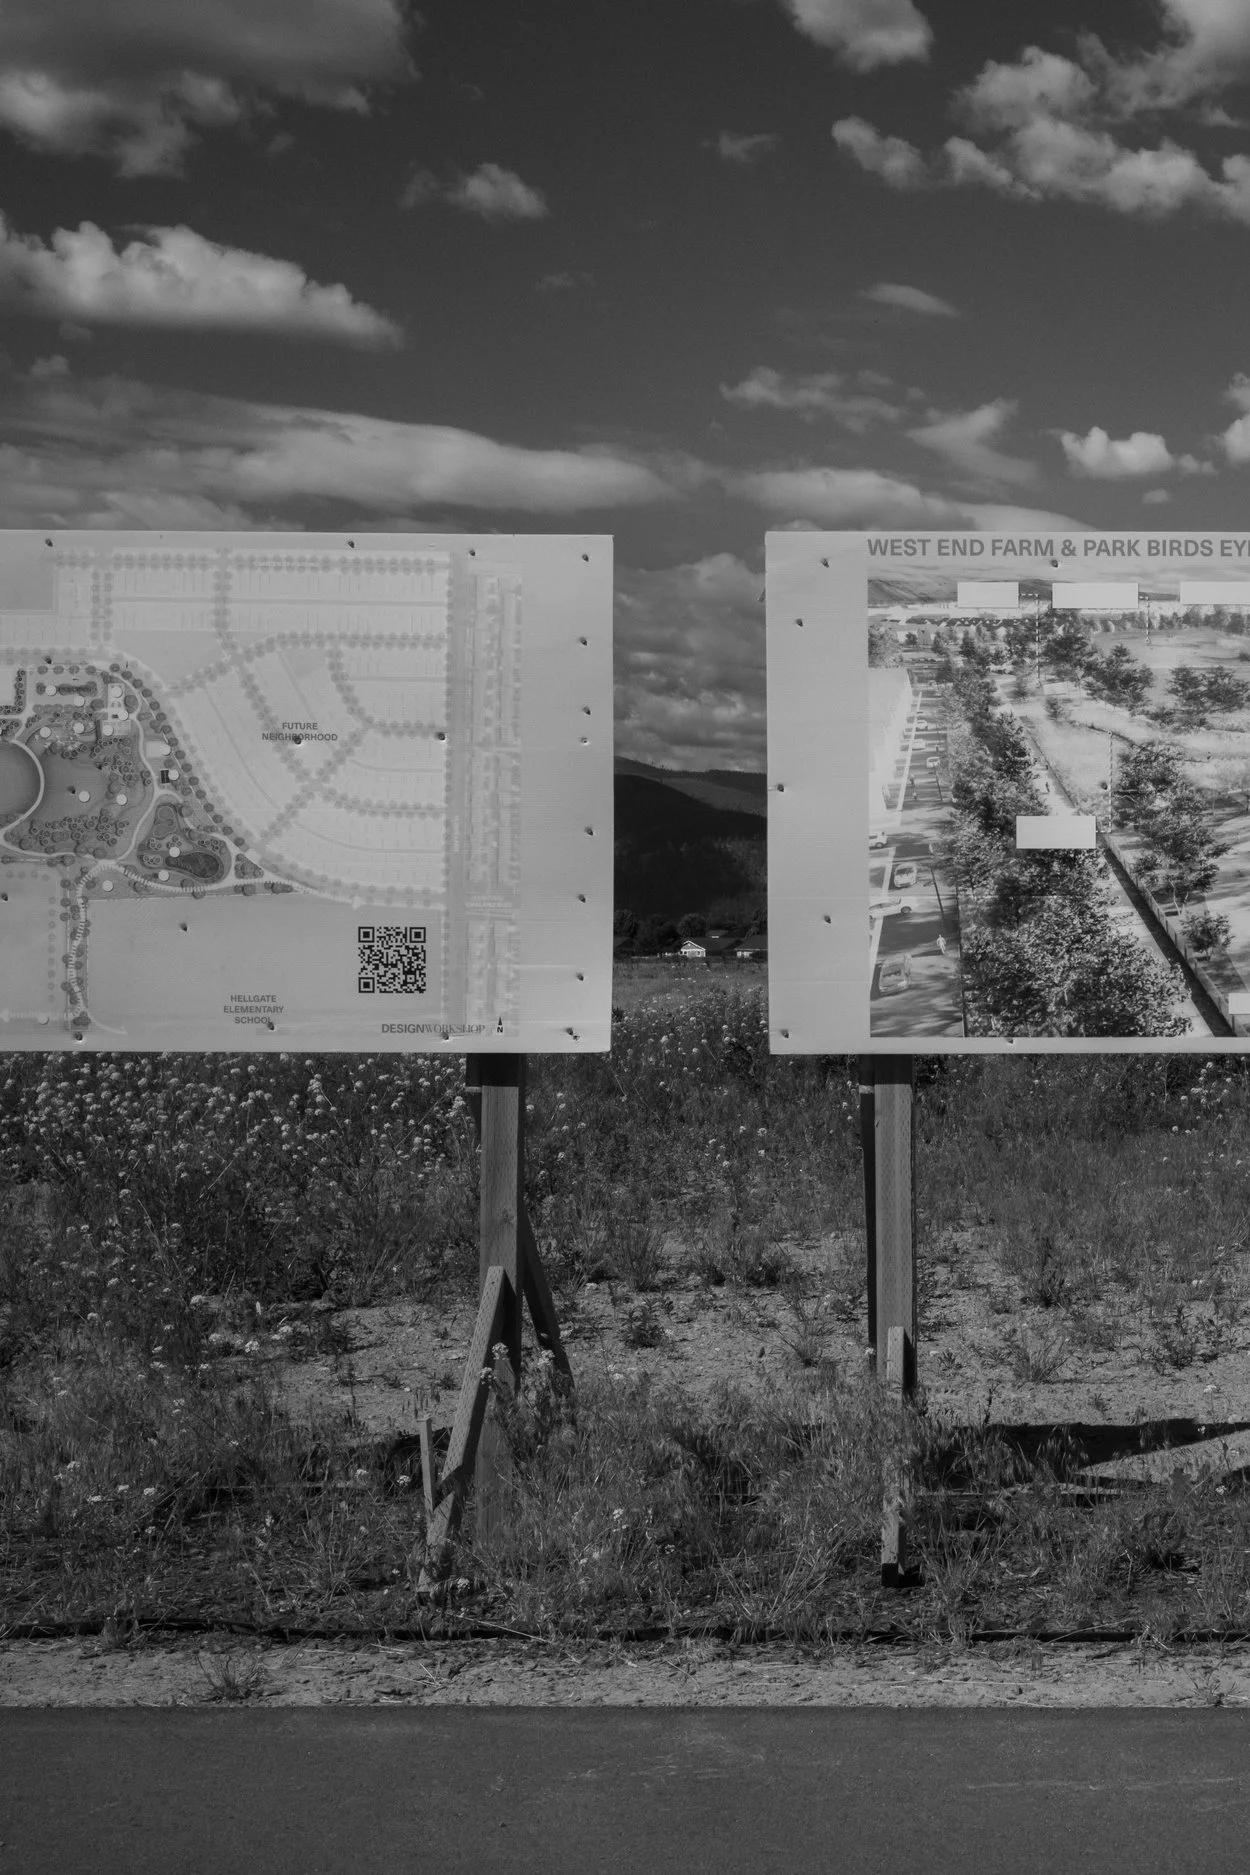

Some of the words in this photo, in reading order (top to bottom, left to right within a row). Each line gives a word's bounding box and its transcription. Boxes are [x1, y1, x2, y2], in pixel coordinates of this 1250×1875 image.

[868, 538, 931, 557] WEST
[938, 538, 985, 557] END
[991, 539, 1054, 557] FARM
[1060, 538, 1078, 557] &
[1083, 539, 1142, 557] PARK
[1147, 539, 1214, 557] BIRDS
[282, 722, 318, 731] FUTURE
[262, 733, 338, 742] NEIGHBORHOOD
[230, 994, 277, 1003] HELLGATE
[223, 1005, 285, 1014] ELEMENTARY
[234, 1016, 272, 1025] SCHOOL
[496, 1026, 504, 1034] N
